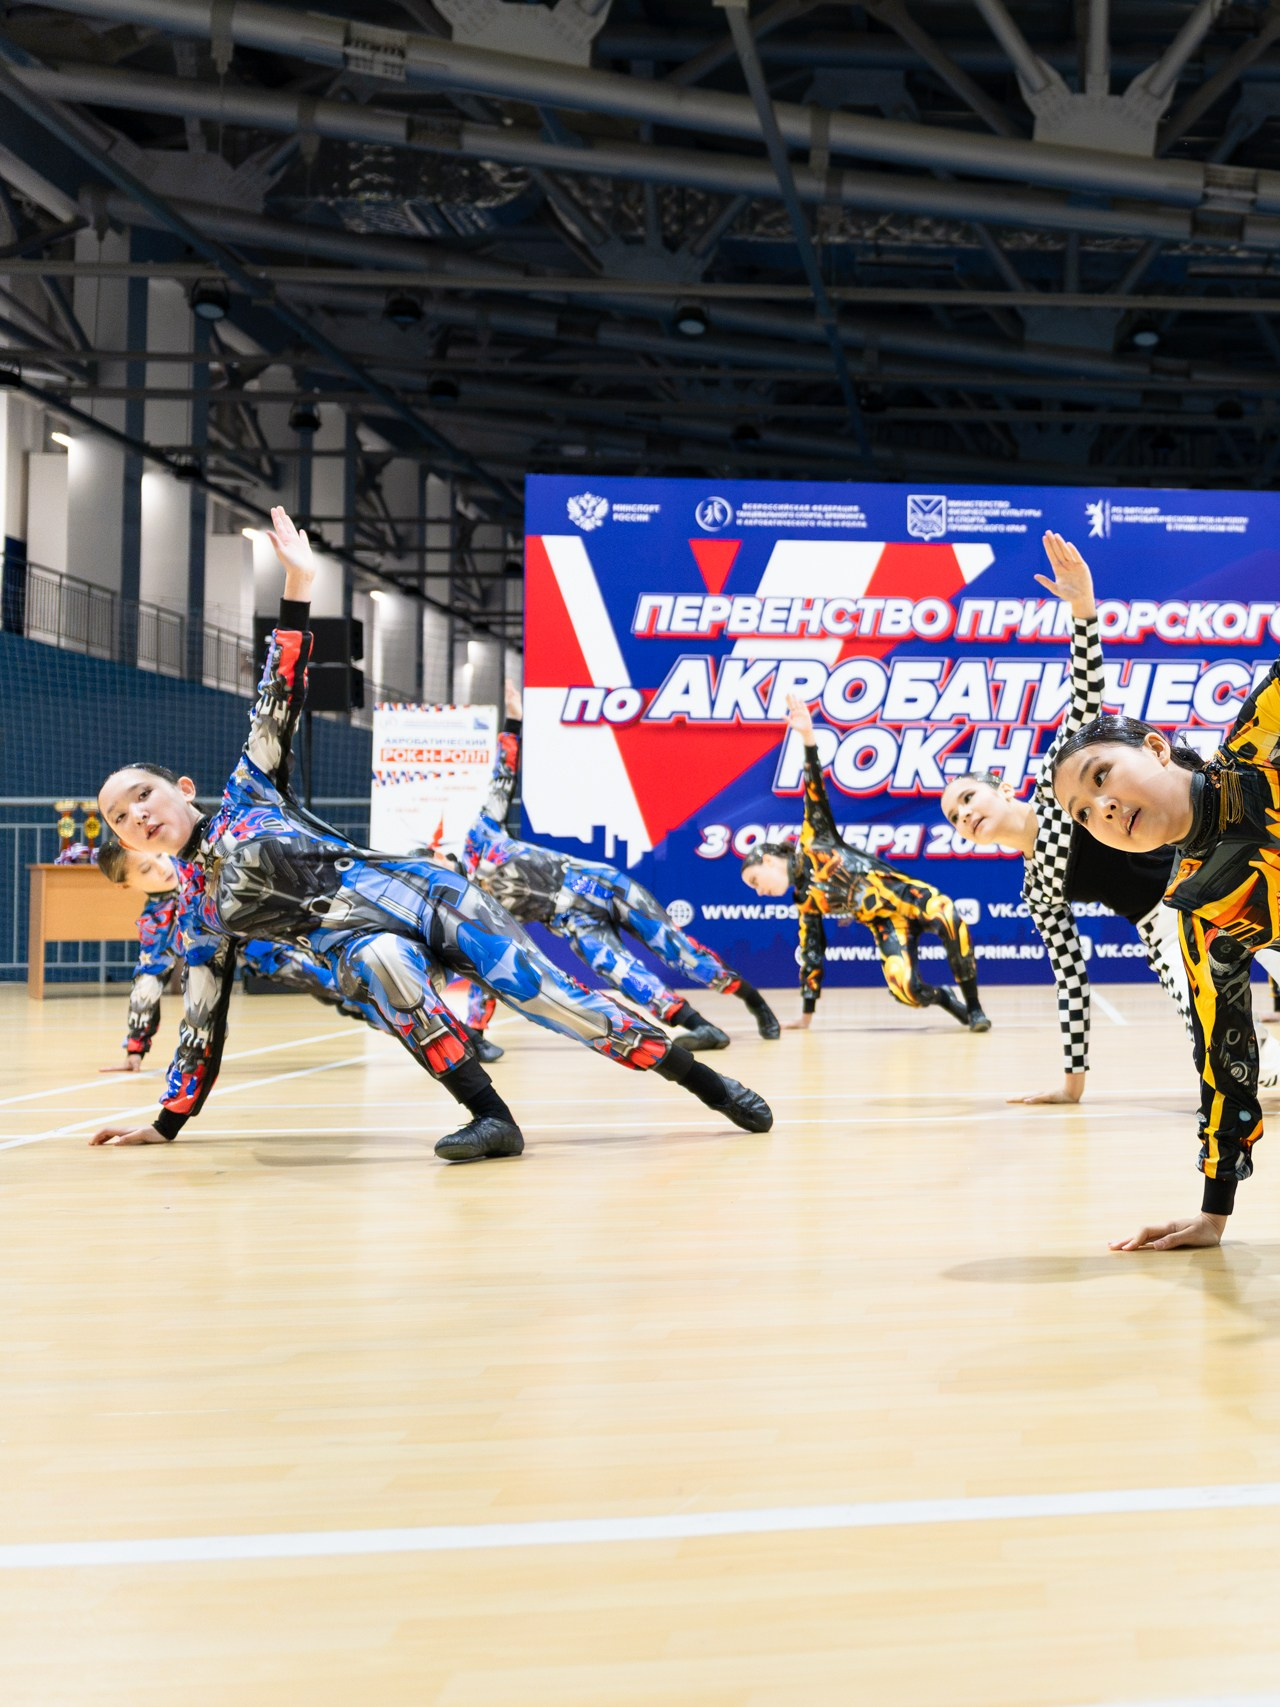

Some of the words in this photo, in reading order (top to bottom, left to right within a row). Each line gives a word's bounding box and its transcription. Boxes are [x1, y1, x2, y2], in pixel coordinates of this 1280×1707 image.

[612, 503, 660, 513] МИНСПОРТ
[612, 512, 650, 523] РОССИИ
[632, 594, 954, 639] ПЕРВЕНСТВО
[384, 737, 487, 746] АКРОБАТИЧЕСКИЙ
[383, 749, 487, 763] РОК-Н-РОЛЛ
[695, 823, 730, 858] 3
